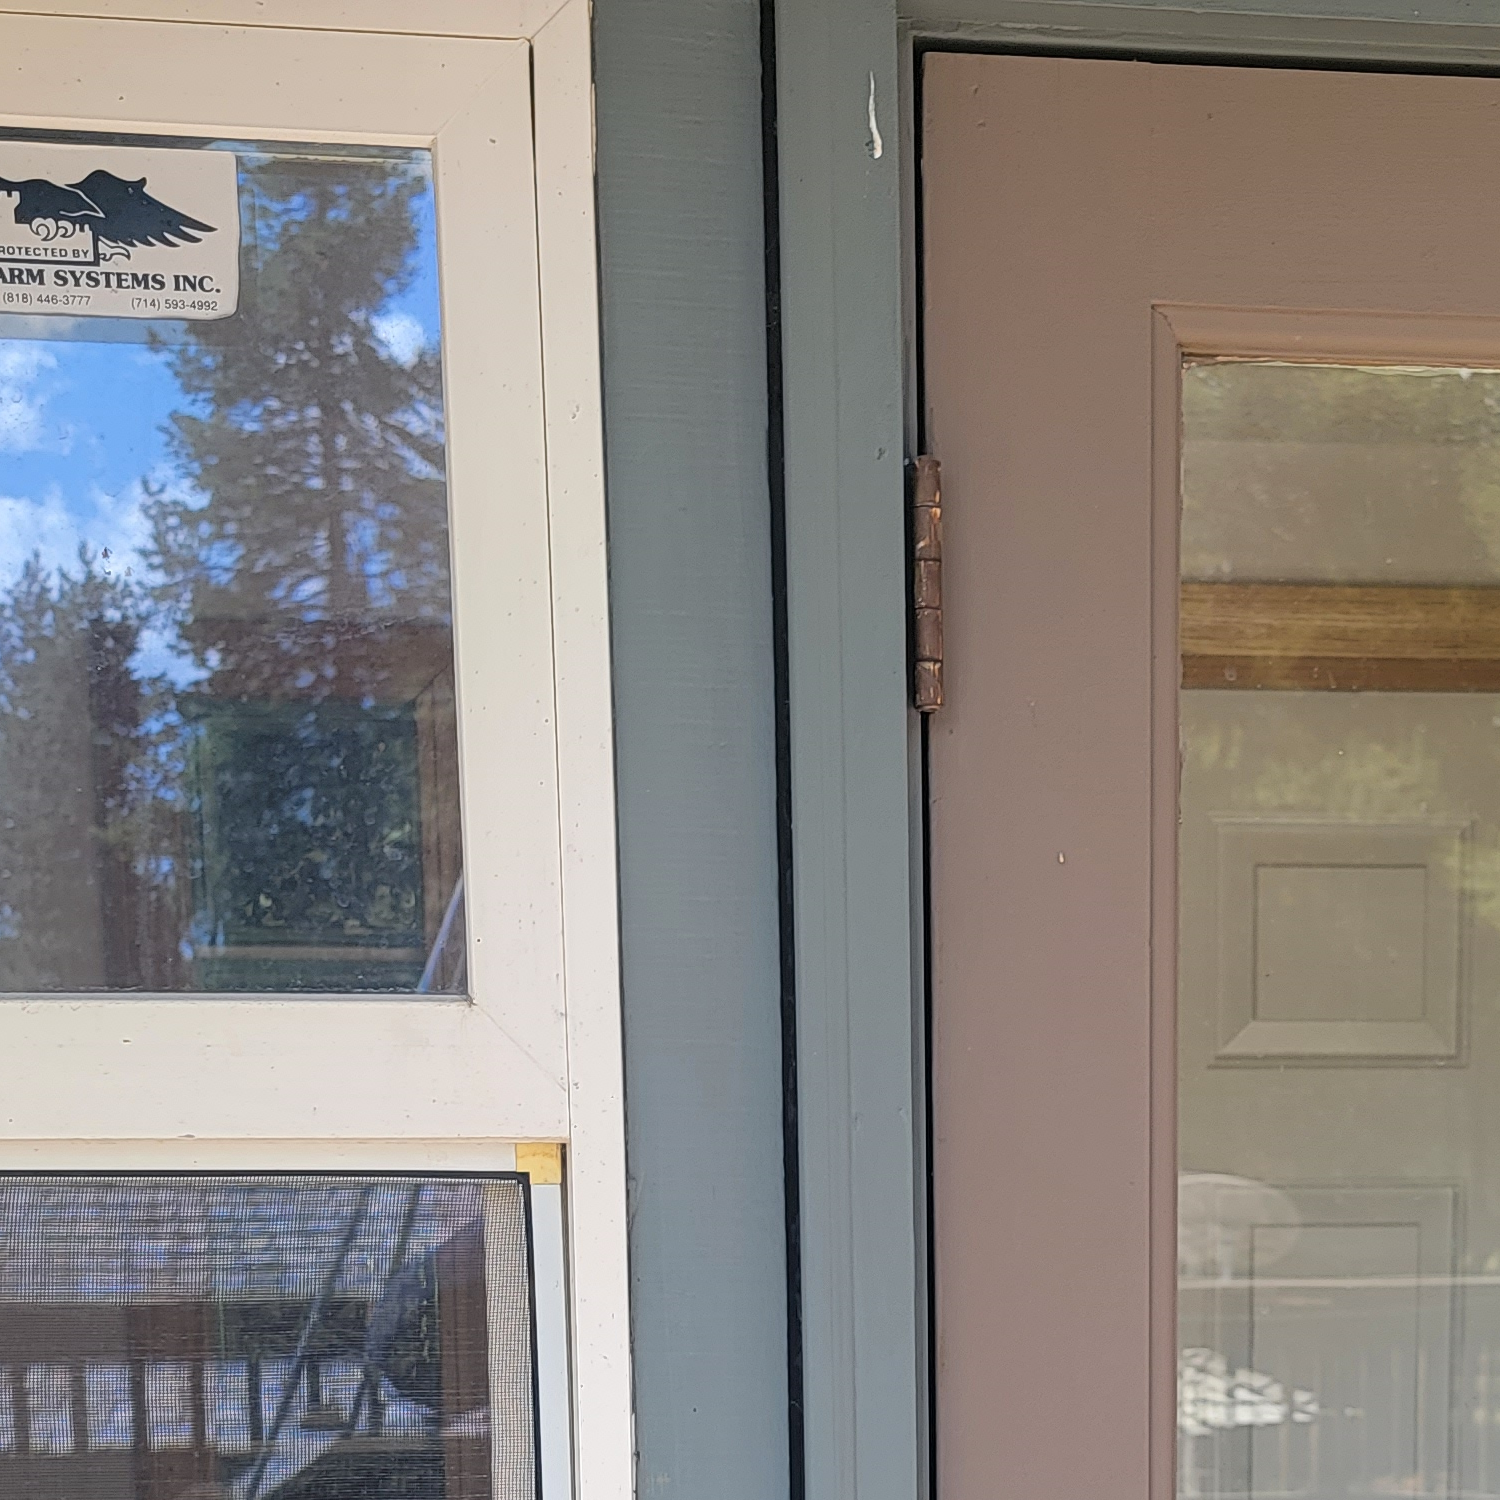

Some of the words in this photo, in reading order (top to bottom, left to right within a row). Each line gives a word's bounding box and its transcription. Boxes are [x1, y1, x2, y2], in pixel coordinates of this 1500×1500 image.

[72, 248, 90, 259] BY
[53, 269, 166, 291] SYSTEMS
[173, 274, 221, 293] INC.
[2, 292, 33, 306] (818)
[36, 294, 91, 306] 446-3777
[131, 297, 161, 311] (714)
[164, 298, 218, 311] 593-4992
